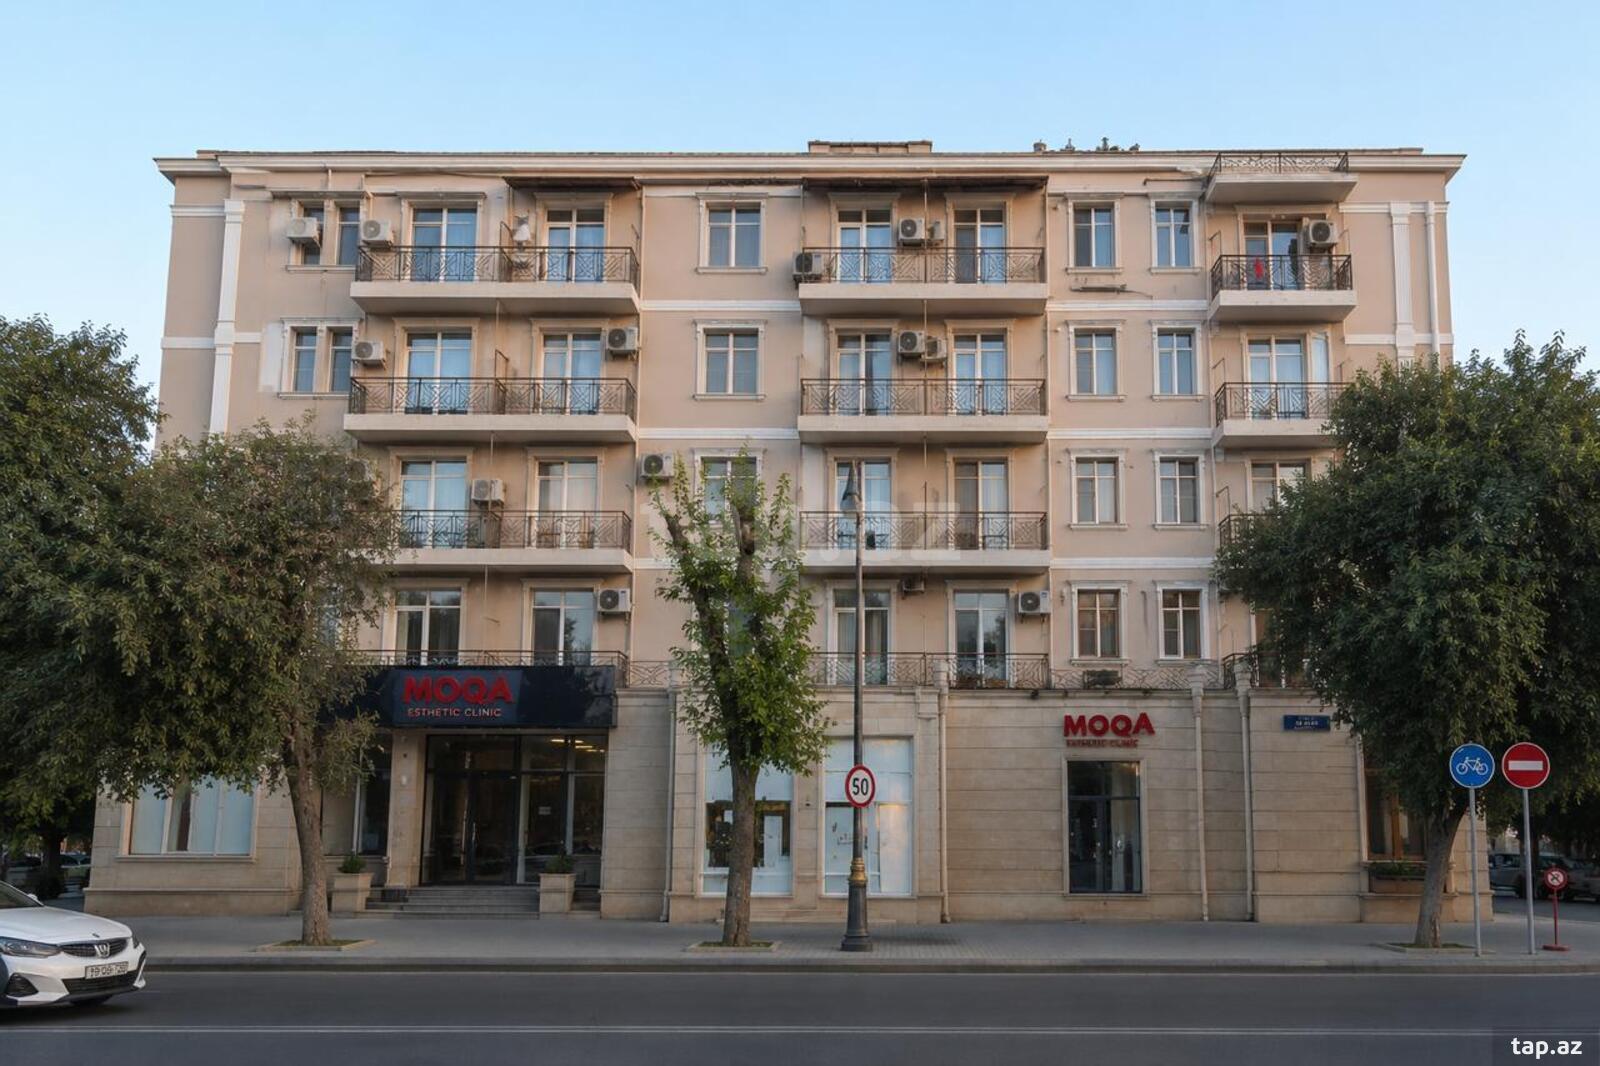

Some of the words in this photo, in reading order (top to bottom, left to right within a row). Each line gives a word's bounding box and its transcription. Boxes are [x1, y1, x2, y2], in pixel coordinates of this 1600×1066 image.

[403, 675, 514, 704] MOQA
[407, 707, 460, 717] ESTHETIC
[464, 707, 502, 717] CLINIC
[1063, 712, 1155, 737] MOQA
[852, 777, 869, 796] 50
